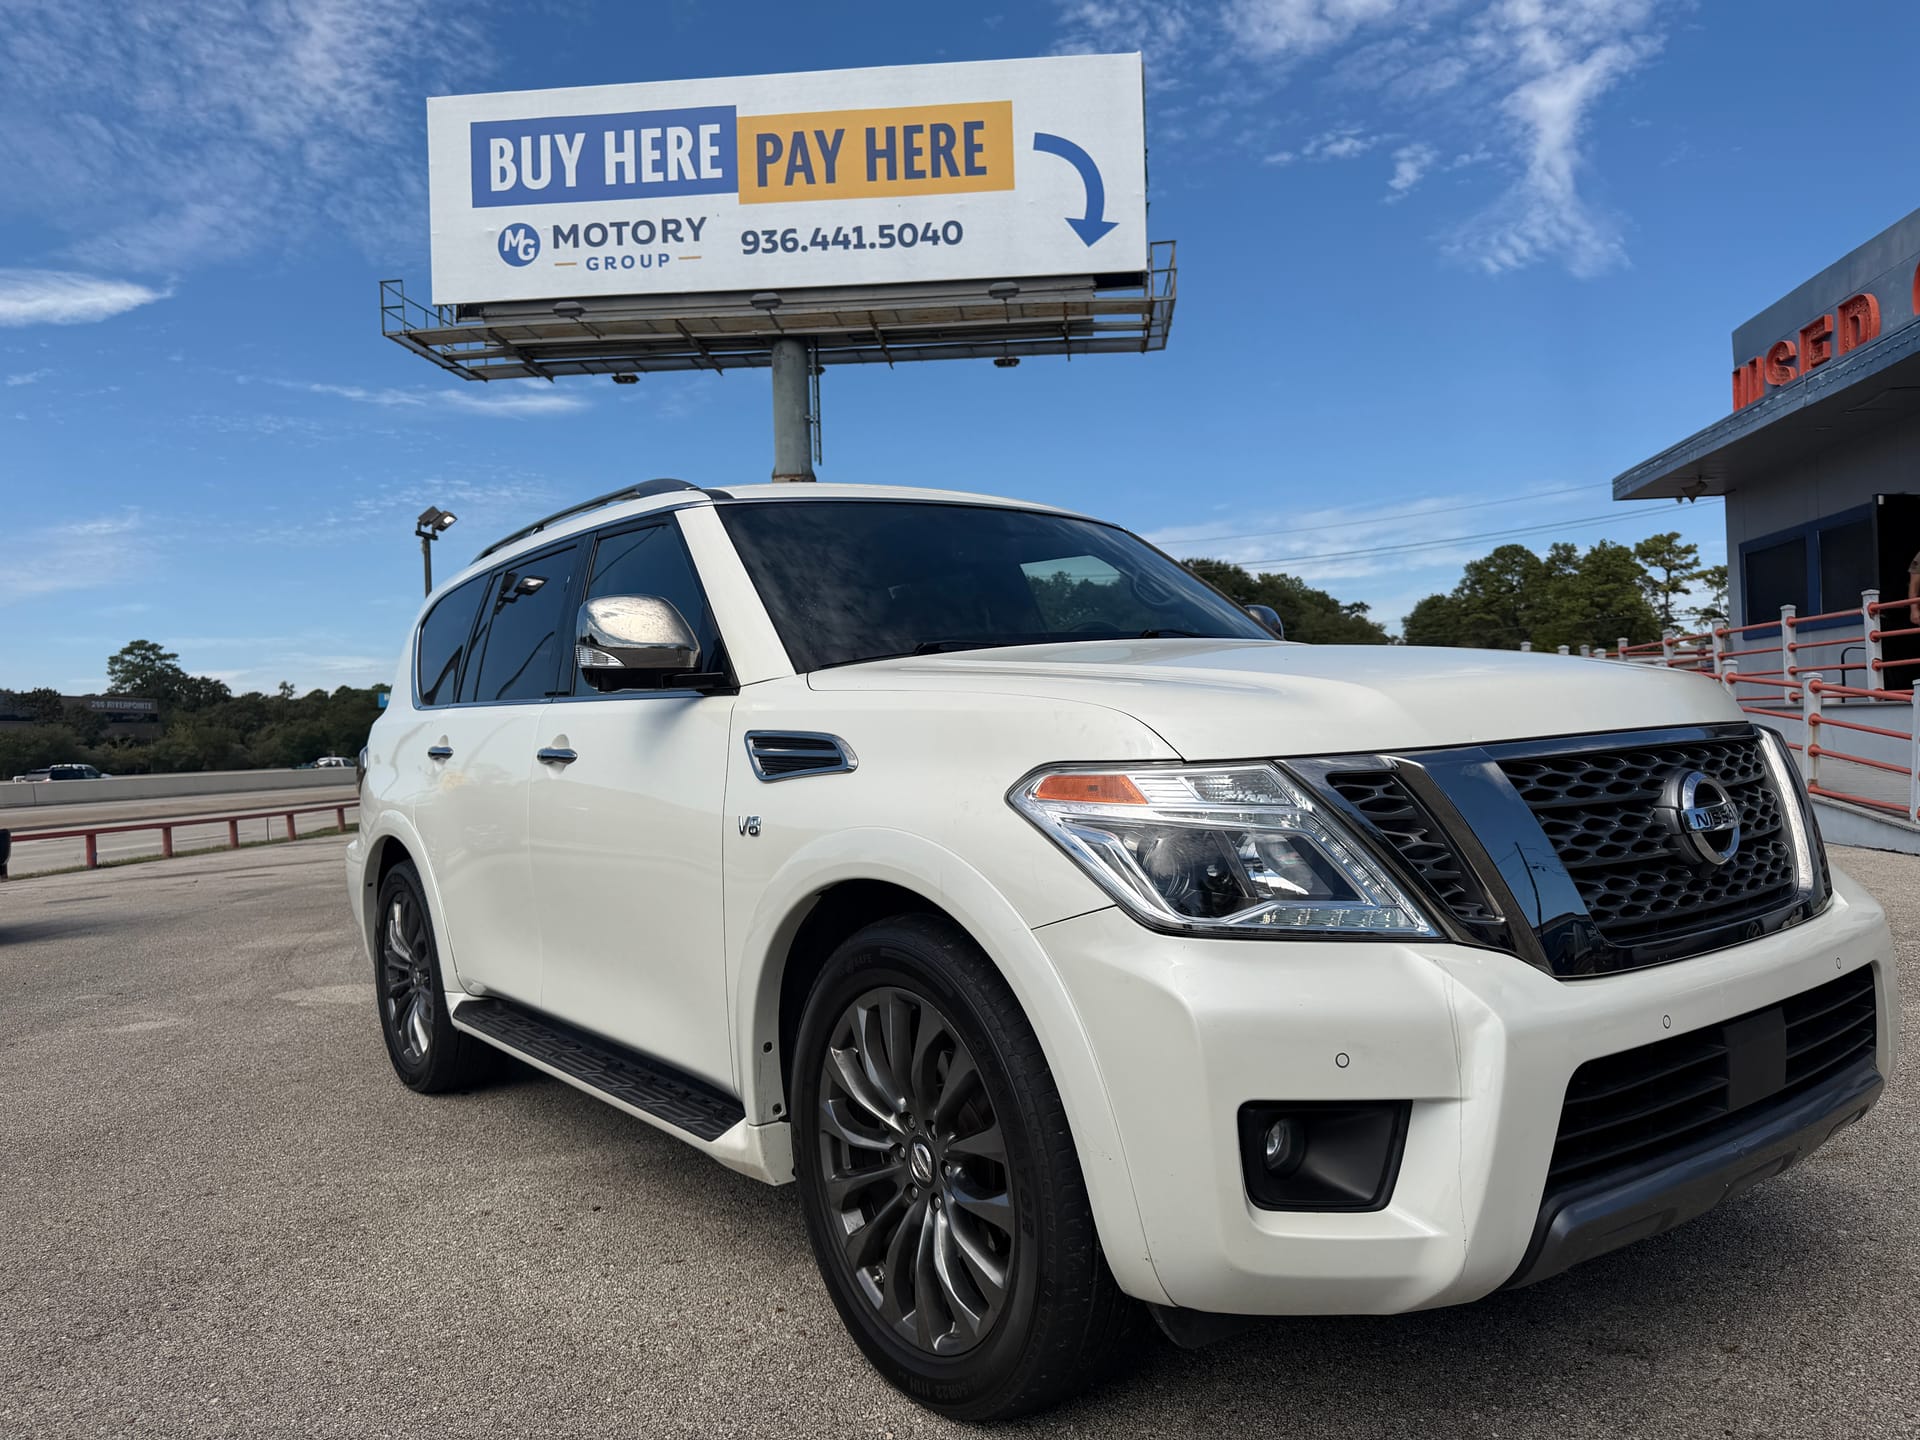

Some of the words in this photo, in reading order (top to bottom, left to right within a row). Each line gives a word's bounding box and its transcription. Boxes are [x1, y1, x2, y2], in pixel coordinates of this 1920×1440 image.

[489, 132, 586, 192] BUY
[604, 123, 724, 185] HERE
[756, 128, 846, 188] PAY
[865, 120, 988, 182] HERE
[503, 228, 536, 261] MG
[552, 216, 707, 250] MOTORY
[740, 220, 964, 256] 936.441.5040
[585, 253, 671, 272] GROUP
[1732, 293, 1881, 412] USED
